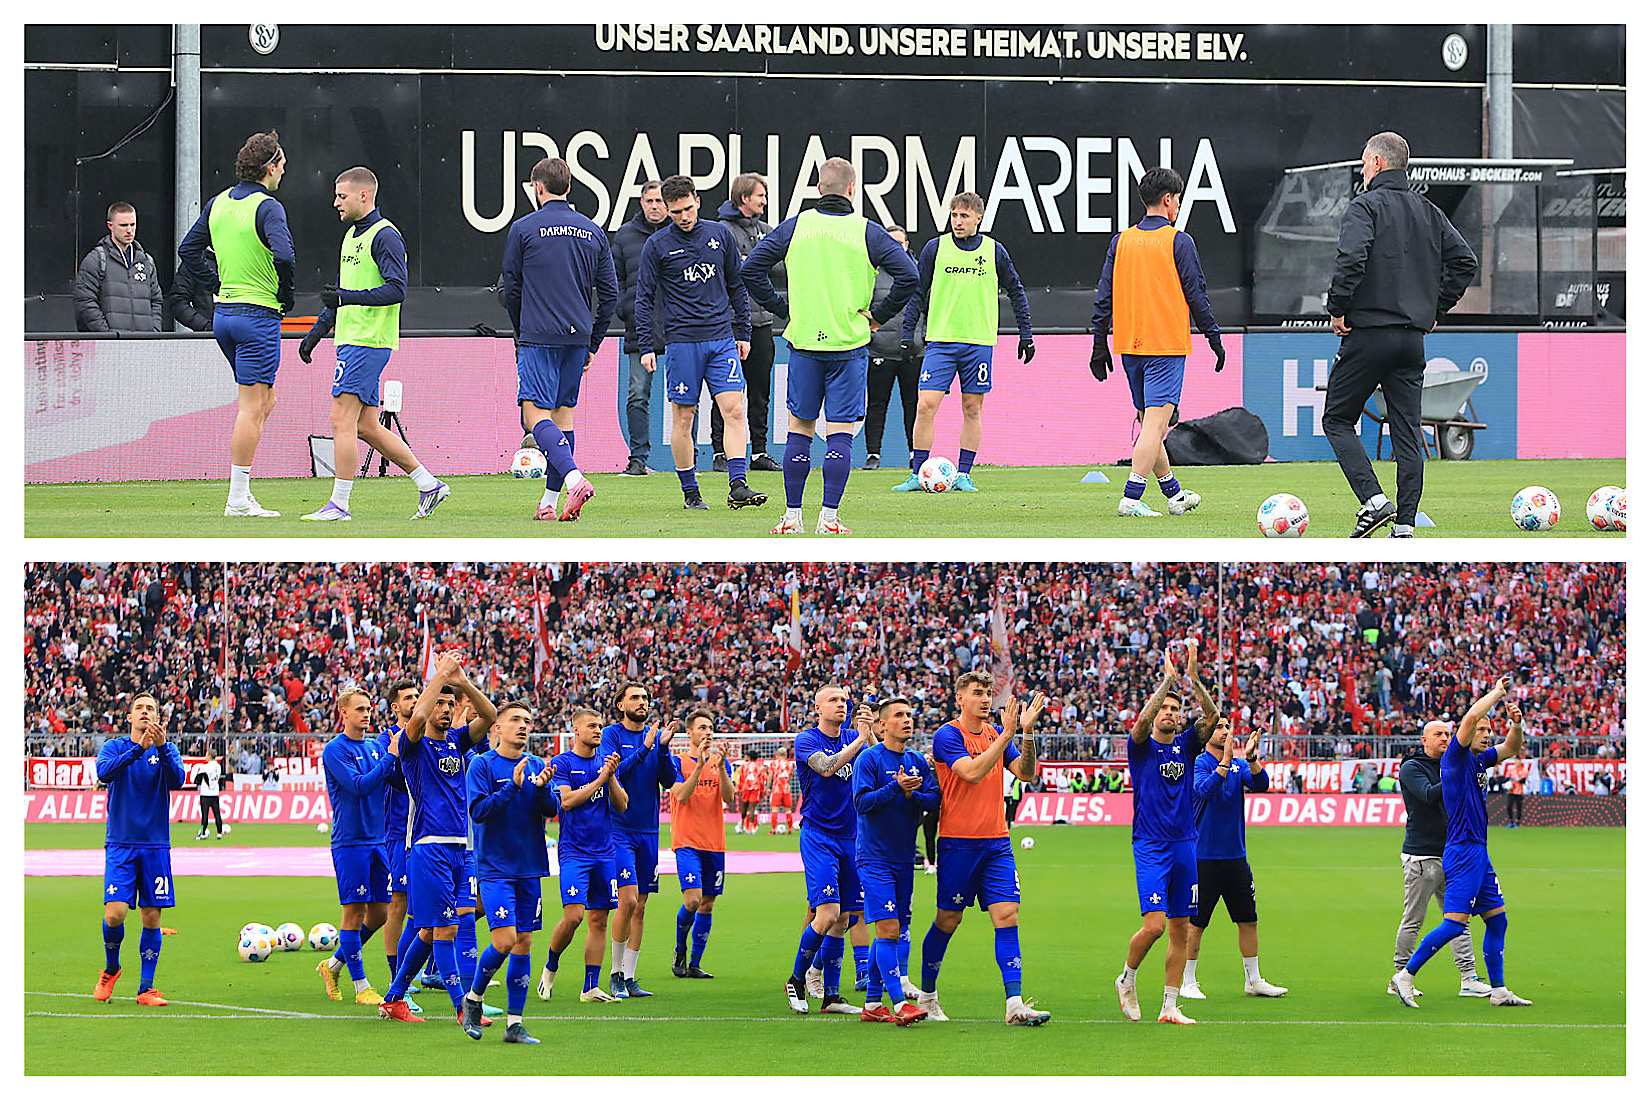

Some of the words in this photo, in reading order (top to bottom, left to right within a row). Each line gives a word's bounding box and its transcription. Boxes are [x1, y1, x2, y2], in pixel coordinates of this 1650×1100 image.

[595, 25, 690, 52] UNSER
[697, 25, 854, 55] SAARLAND.
[859, 27, 967, 57] UNSERE
[973, 29, 1082, 59] HEIMAT.
[1087, 31, 1190, 60] UNSERE
[1196, 33, 1248, 61] ELV.
[539, 225, 593, 241] DARMSTADT
[944, 266, 978, 275] CRAFT
[728, 357, 740, 378] 2
[977, 362, 989, 382] 8
[38, 794, 108, 820] ALLE
[218, 794, 283, 820] SIND
[289, 795, 335, 820] DA
[1018, 796, 1112, 823] ALLES.
[1278, 797, 1337, 823] DAS
